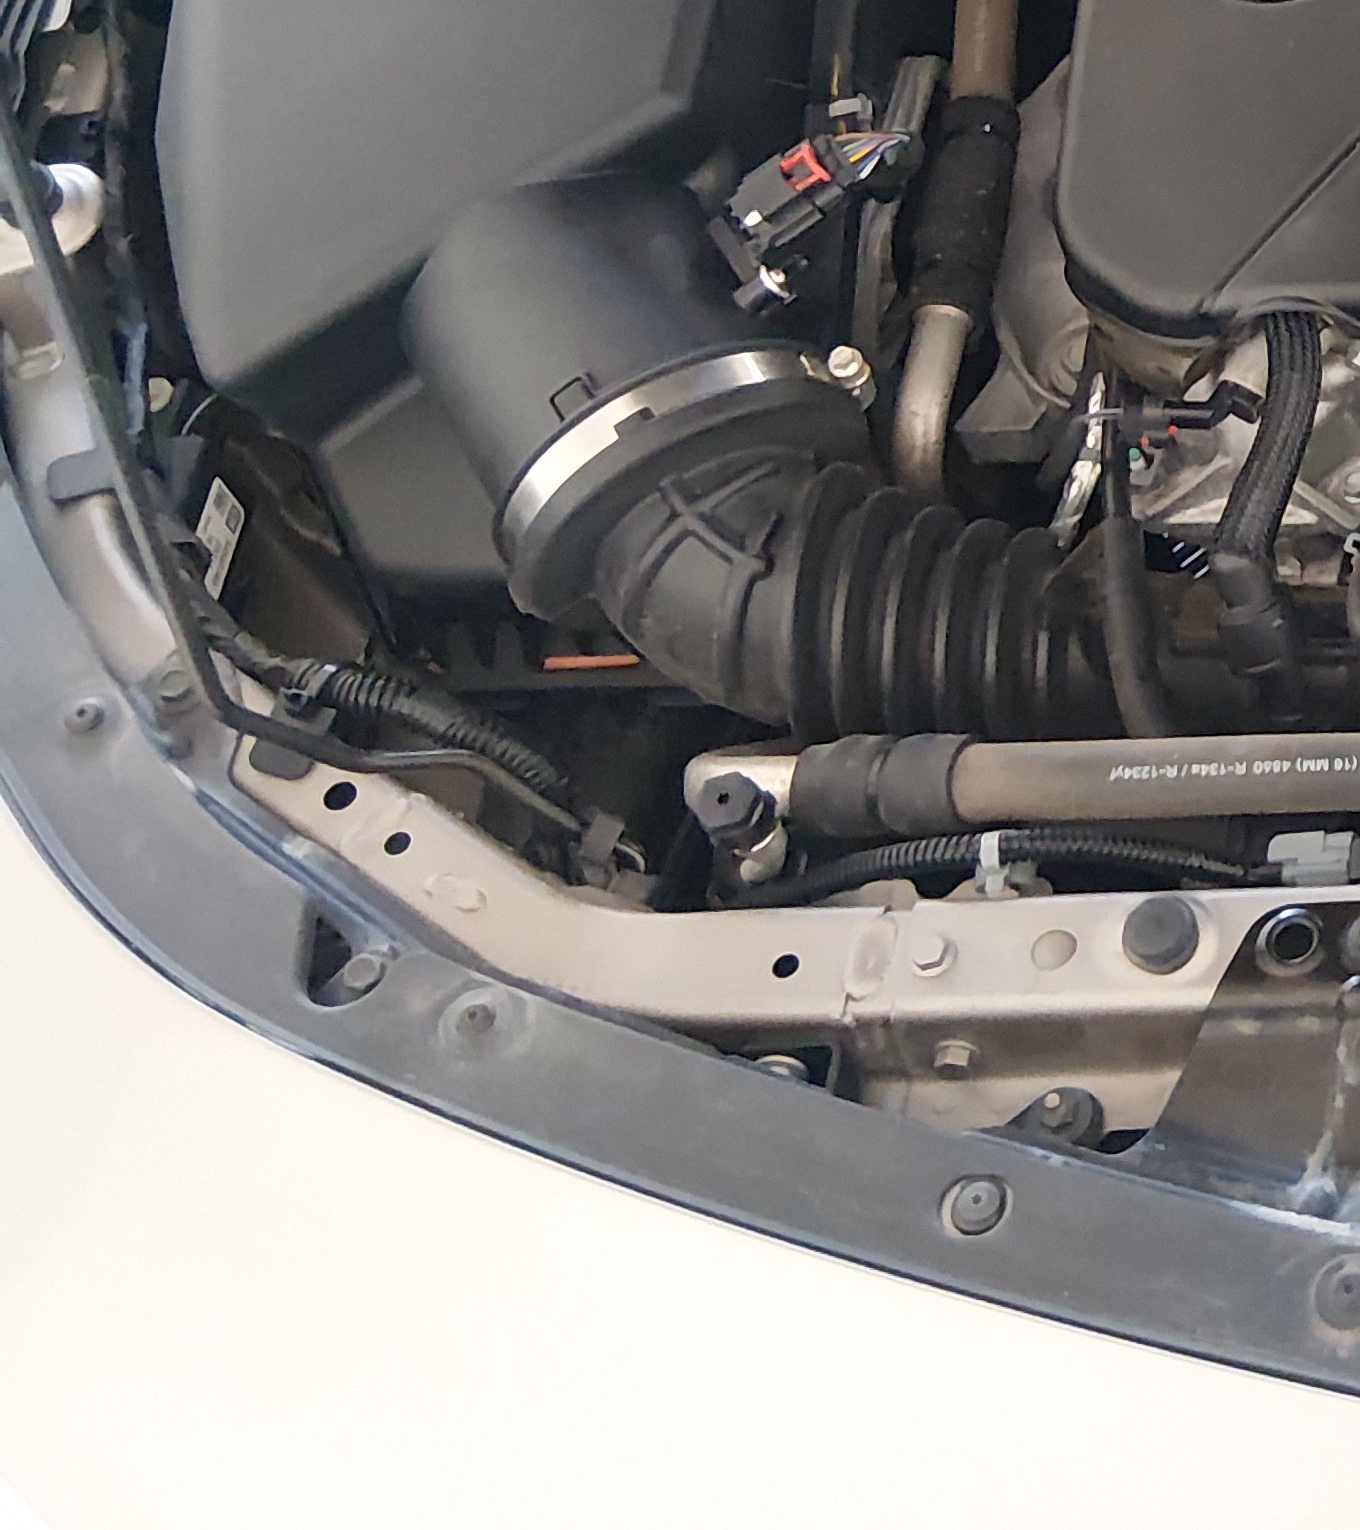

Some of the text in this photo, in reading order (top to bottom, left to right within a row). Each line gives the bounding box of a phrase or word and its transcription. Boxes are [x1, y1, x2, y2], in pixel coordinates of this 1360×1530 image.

[1108, 764, 1178, 782] R-1234yf
[1191, 761, 1247, 777] R-134a
[1296, 756, 1329, 773] MM)
